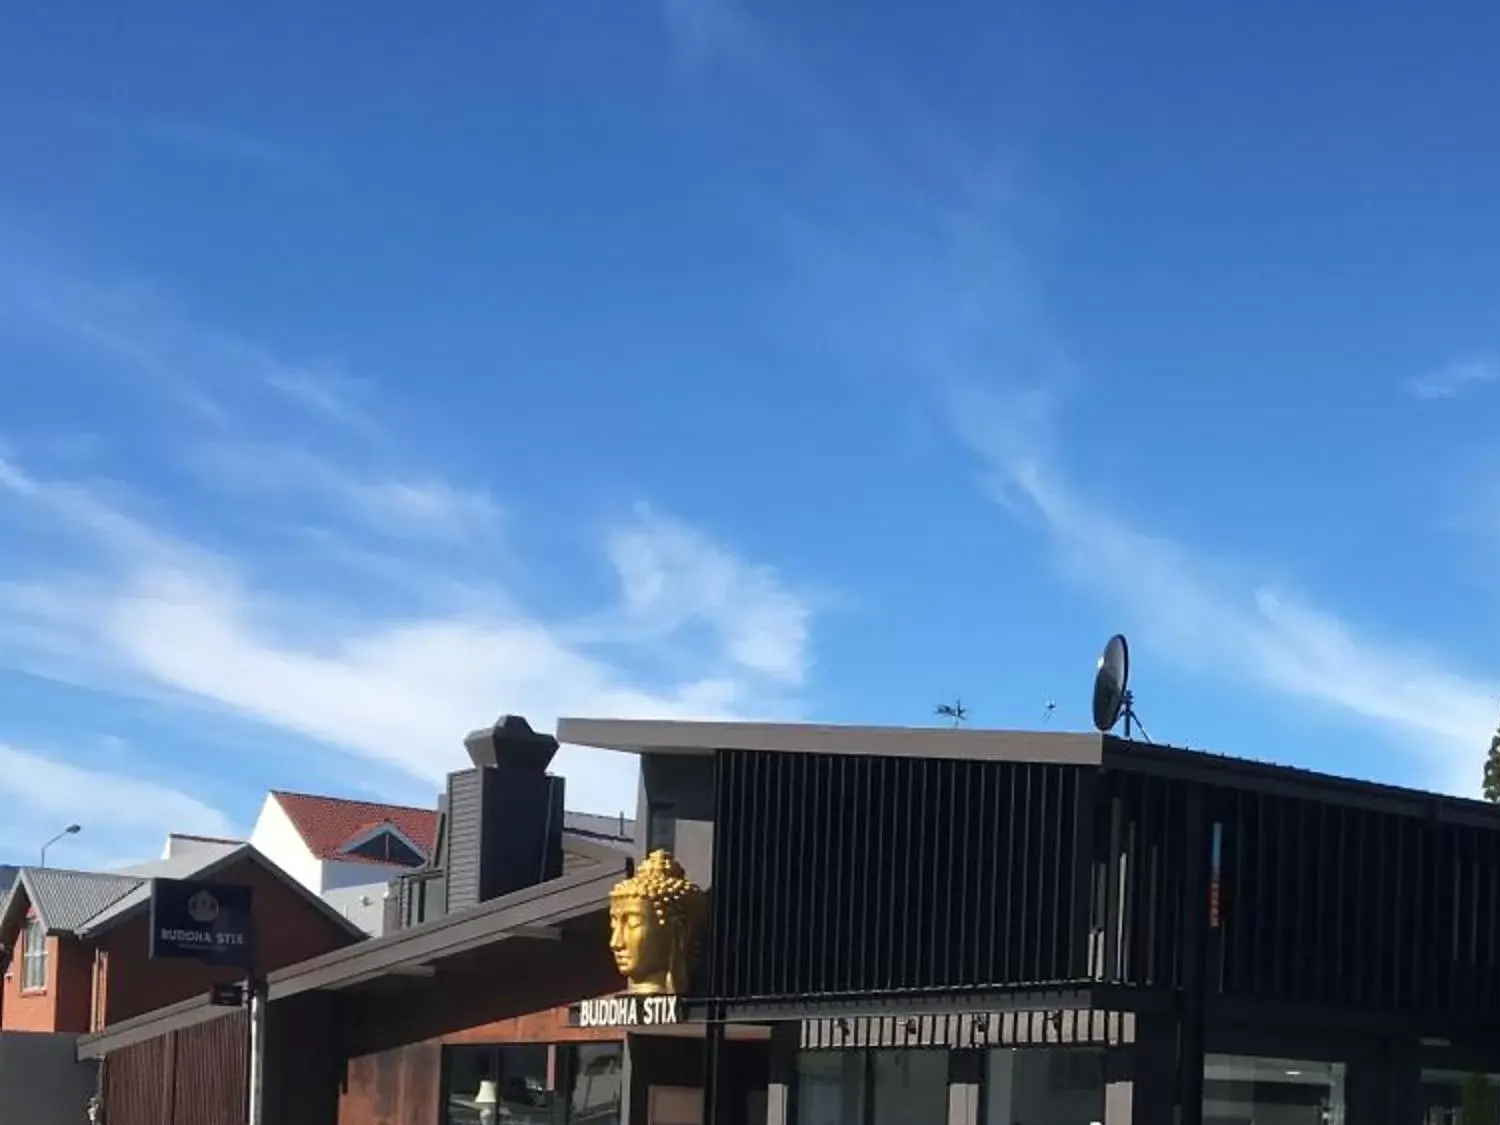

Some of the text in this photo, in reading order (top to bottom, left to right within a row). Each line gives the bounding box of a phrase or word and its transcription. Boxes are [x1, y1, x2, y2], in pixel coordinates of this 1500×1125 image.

[161, 928, 244, 945] BUDDHA STIX
[580, 995, 678, 1028] BUDDHA STIX
